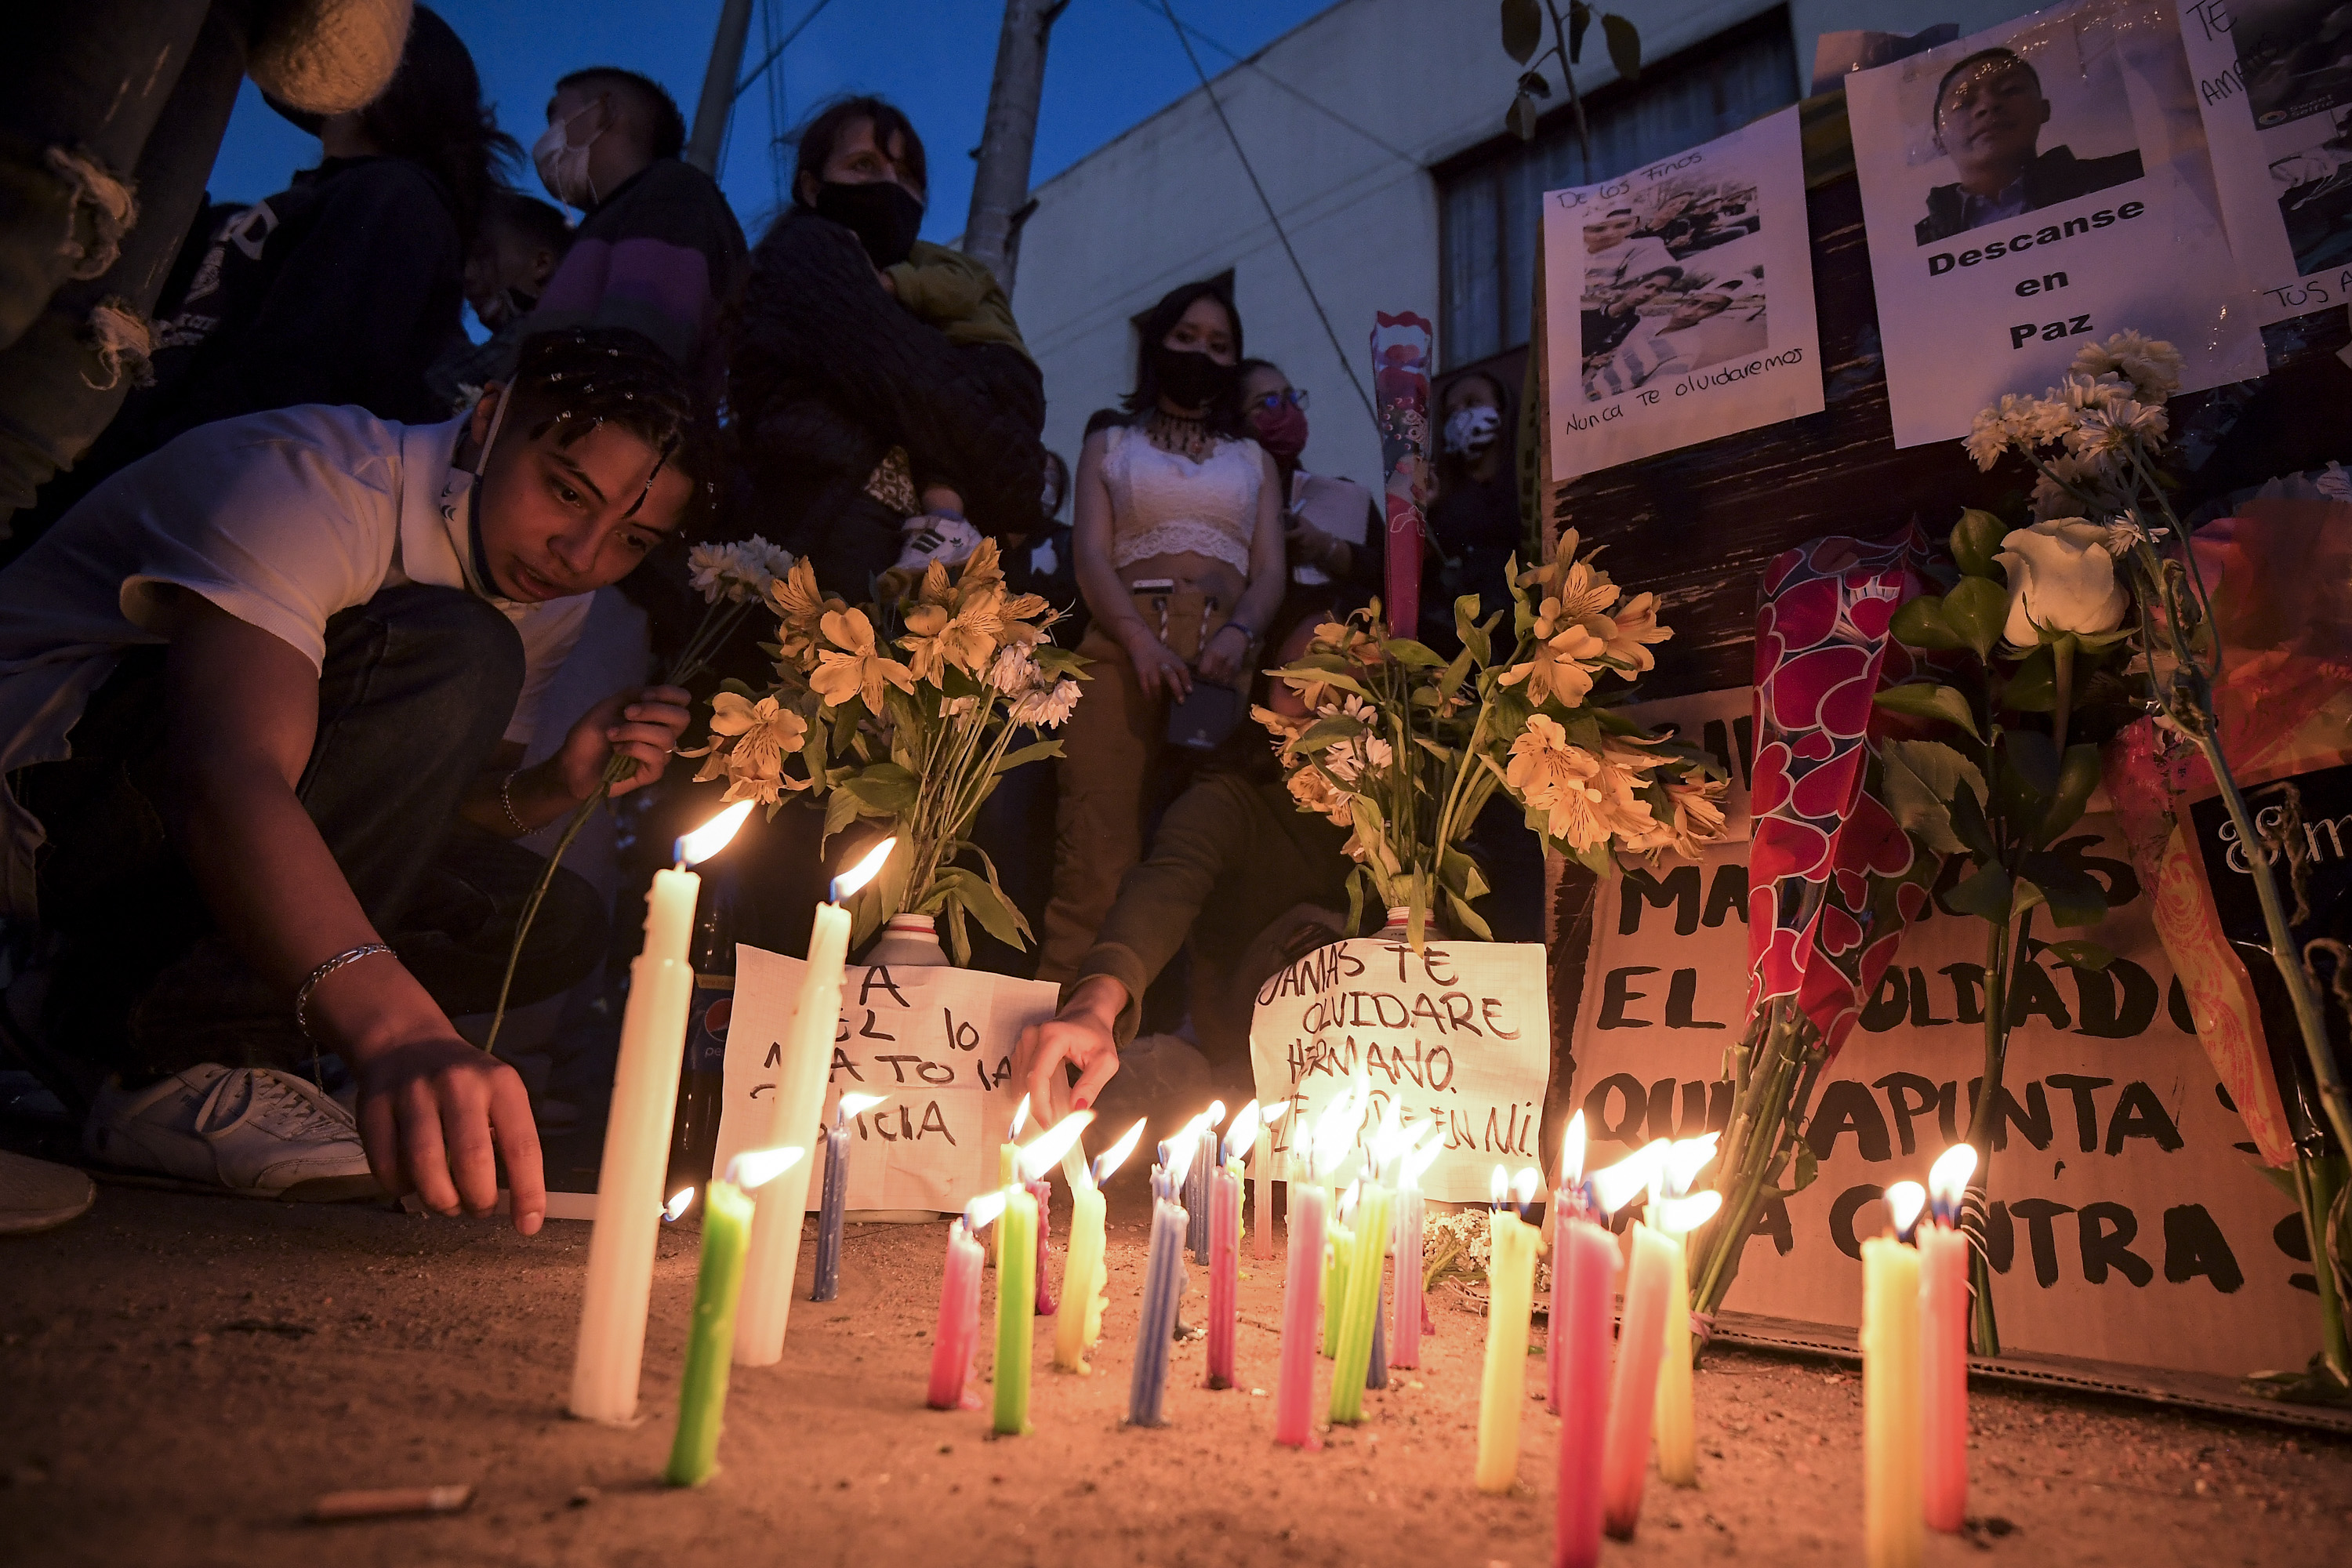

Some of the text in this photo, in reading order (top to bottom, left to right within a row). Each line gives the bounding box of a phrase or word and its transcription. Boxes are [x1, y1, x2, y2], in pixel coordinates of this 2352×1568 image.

[2186, 0, 2238, 42] TE
[1927, 199, 2146, 278] Descanse
[2015, 268, 2070, 297] en
[2263, 280, 2328, 307] TUS
[2009, 313, 2094, 350] Paz
[1566, 405, 1624, 435] Nunca
[1675, 347, 1803, 397] olvidaremos
[858, 965, 911, 1008] A
[1257, 941, 1459, 1006] JAMAS TE
[1596, 966, 1726, 1030] EL
[1302, 991, 1522, 1040] OLVIDARE
[1806, 1071, 2185, 1162] APUNTA
